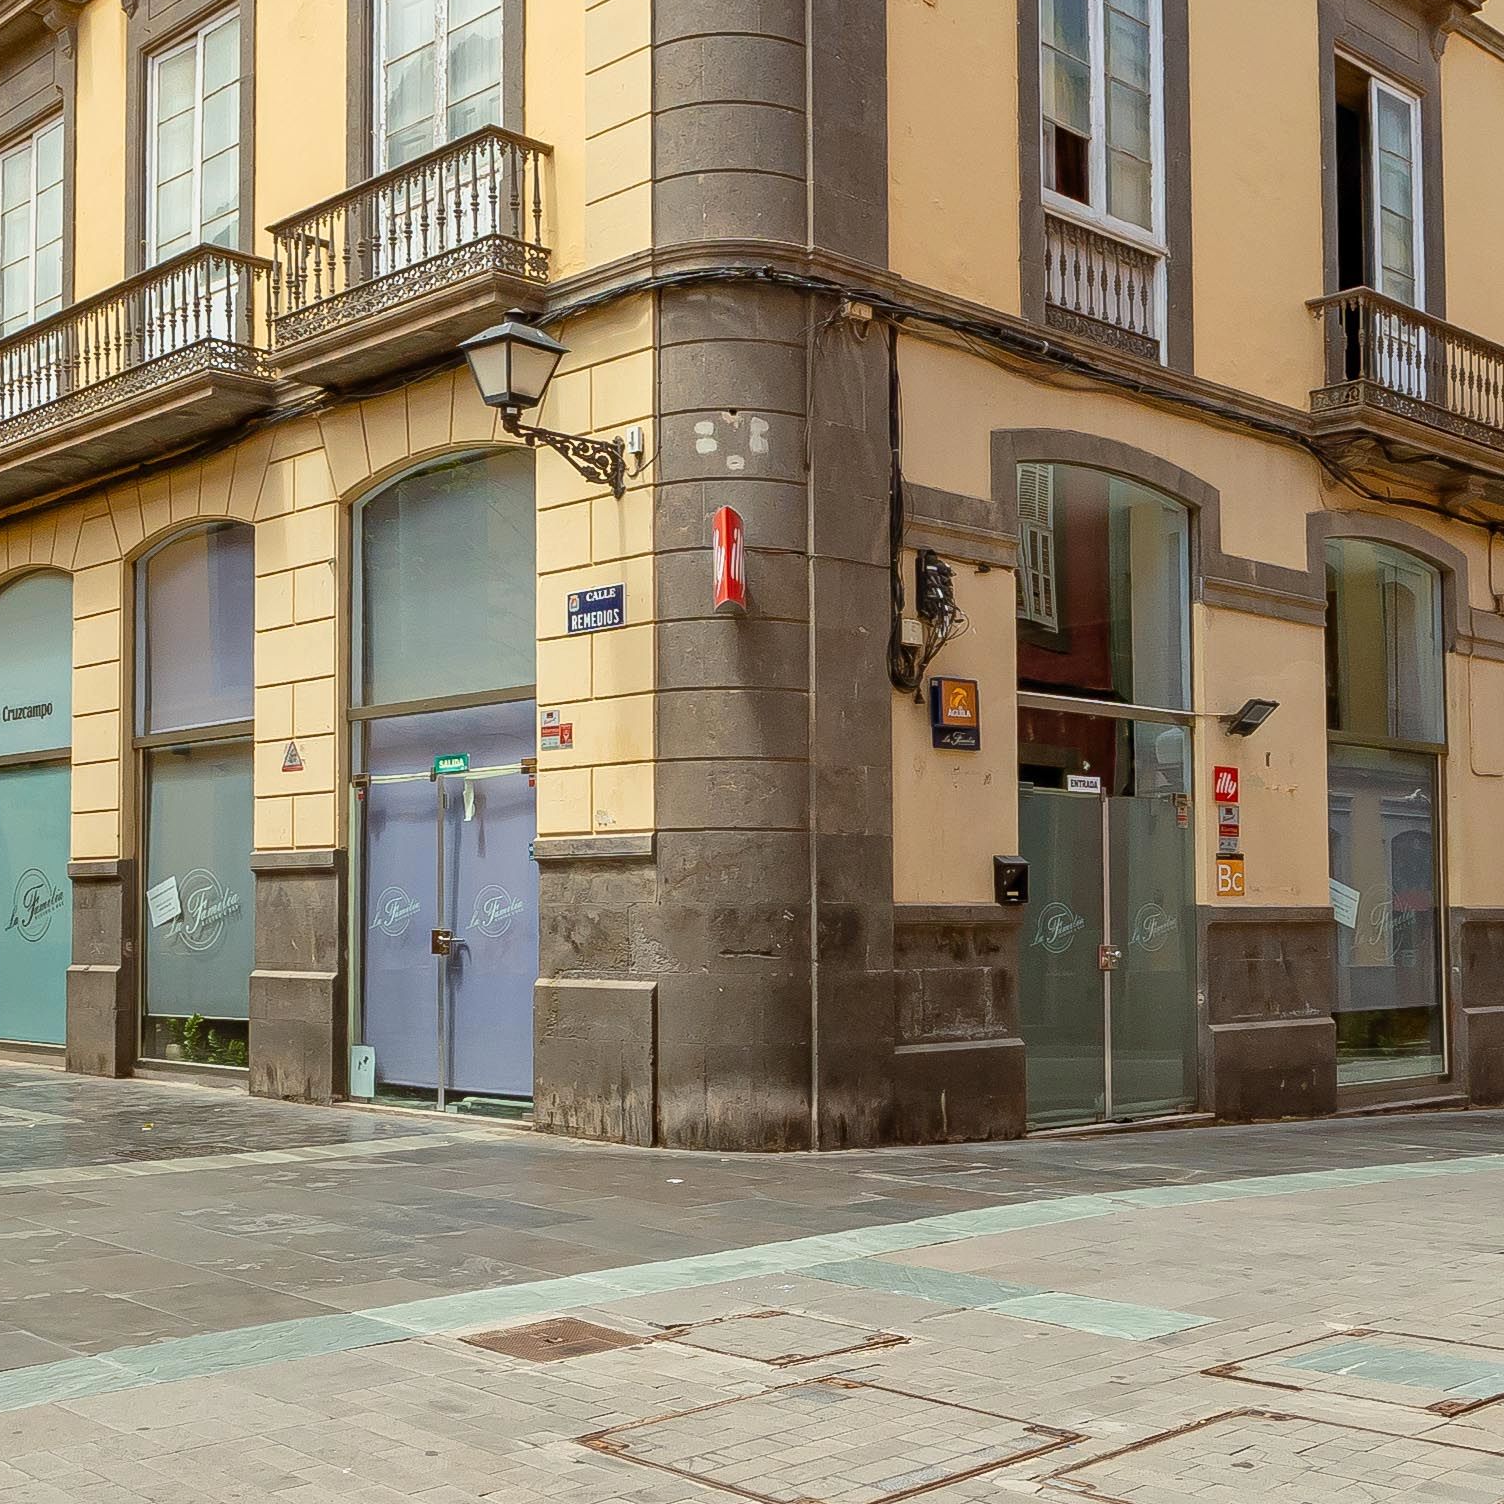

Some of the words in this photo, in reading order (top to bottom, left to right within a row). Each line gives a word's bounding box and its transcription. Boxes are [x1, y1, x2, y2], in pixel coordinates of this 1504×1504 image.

[585, 587, 616, 602] CALLE
[571, 608, 620, 630] REMEDIOS
[2, 701, 53, 722] Cruzcampo
[438, 757, 465, 769] SALIDA
[1070, 778, 1099, 789] ENTRADA
[1216, 772, 1237, 799] illy
[1218, 864, 1243, 892] Bc
